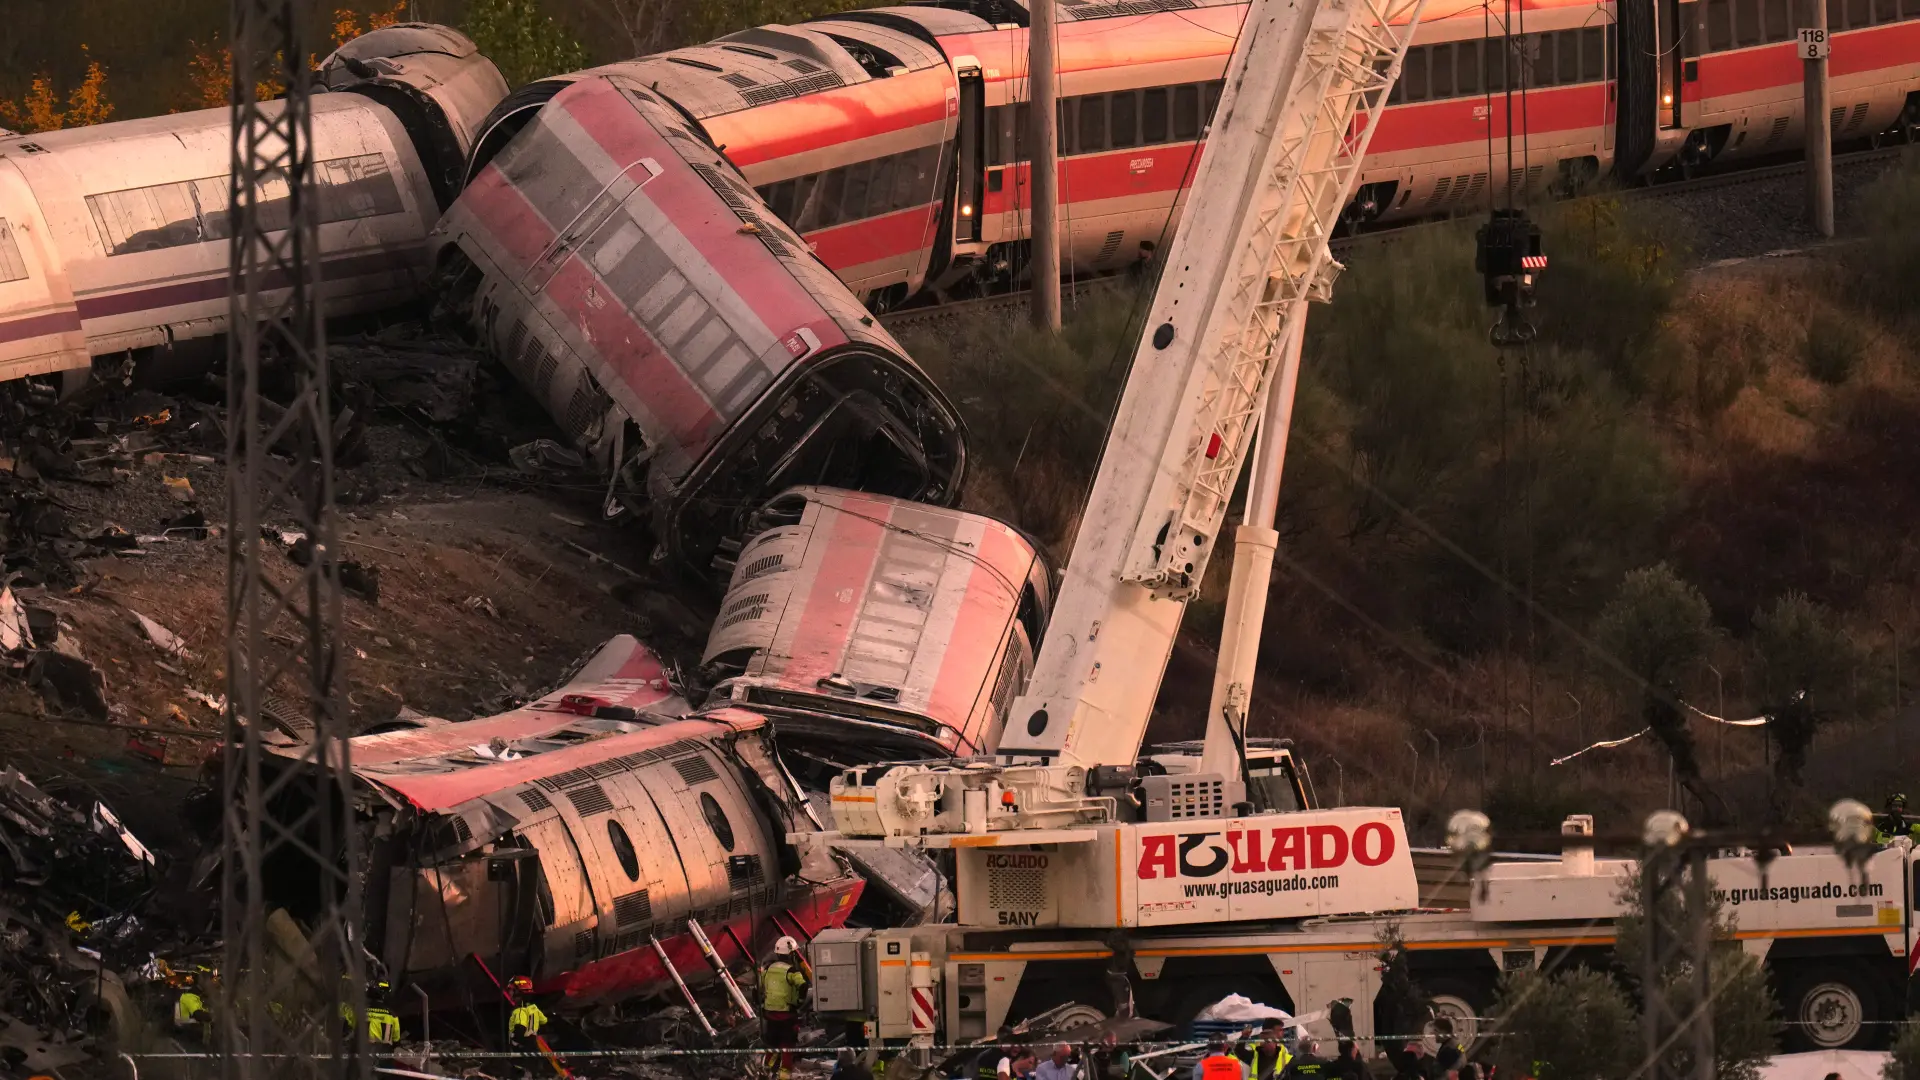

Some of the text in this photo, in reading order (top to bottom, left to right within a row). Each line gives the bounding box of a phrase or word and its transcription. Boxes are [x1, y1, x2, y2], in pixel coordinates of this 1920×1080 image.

[1801, 30, 1824, 43] 118
[1808, 44, 1818, 57] 8
[1137, 822, 1395, 880] AGUADO
[1183, 874, 1339, 899] www.gruasaguado.com
[1707, 882, 1884, 906] w.gruasaguado.com
[998, 911, 1039, 926] SANY
